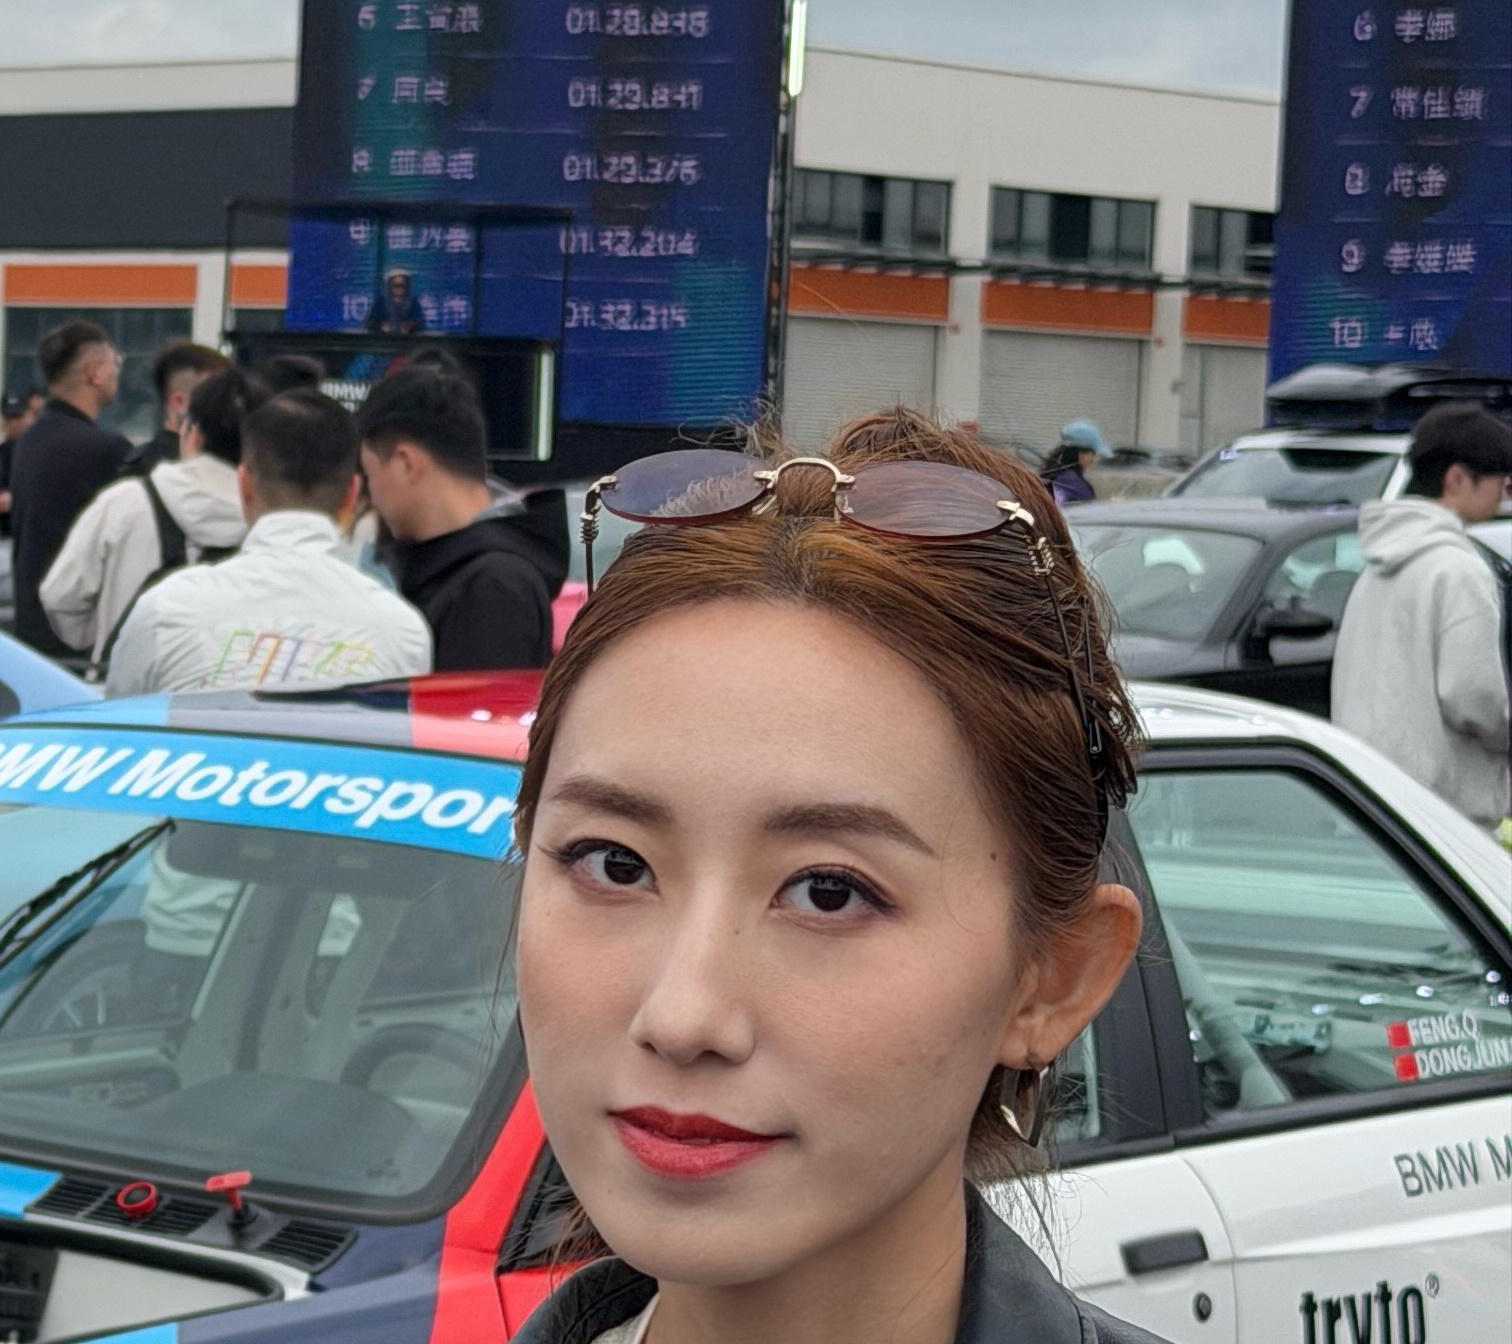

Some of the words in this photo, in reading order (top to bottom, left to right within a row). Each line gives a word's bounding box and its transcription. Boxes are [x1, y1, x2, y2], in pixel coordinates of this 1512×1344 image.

[358, 4, 377, 31] 6
[1354, 9, 1377, 41] 6
[1350, 85, 1373, 118] 7
[1345, 163, 1368, 195] 8
[1342, 240, 1364, 272] 9
[343, 294, 370, 321] 10
[1329, 317, 1366, 348] 10
[109, 748, 518, 836] Motorspor
[1393, 1140, 1480, 1197] BMW
